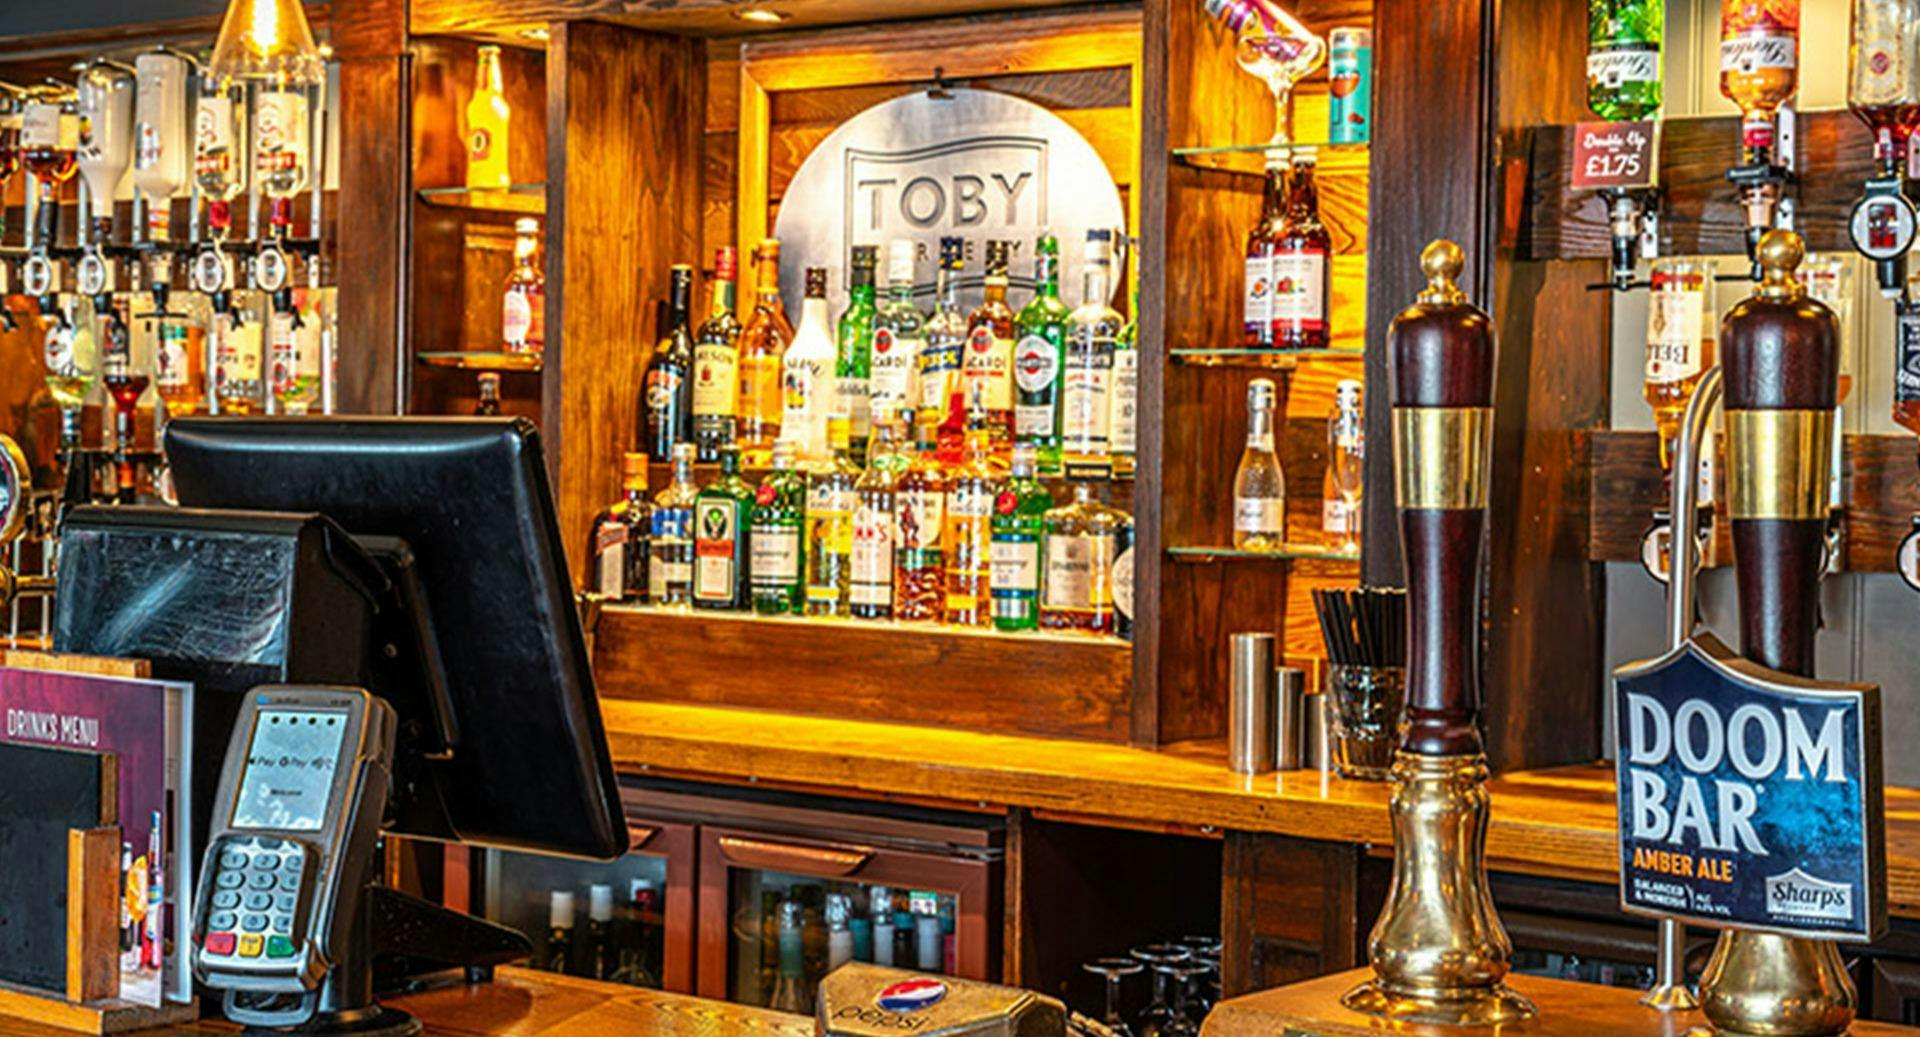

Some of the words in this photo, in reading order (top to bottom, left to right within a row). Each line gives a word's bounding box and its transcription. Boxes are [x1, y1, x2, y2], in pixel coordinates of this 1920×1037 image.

[1583, 132, 1624, 149] Double
[1626, 131, 1646, 151] Up
[1584, 154, 1640, 177] £1.75
[858, 172, 1032, 231] TOBY
[7, 708, 58, 742] DRINKS
[60, 715, 99, 747] MENU
[1627, 692, 1847, 782] DOOM
[1630, 767, 1769, 856] BAR
[1632, 847, 1694, 877] AMBER
[1697, 857, 1734, 883] ALE
[1773, 881, 1846, 909] Sharp's
[831, 1005, 930, 1030] pepsi
